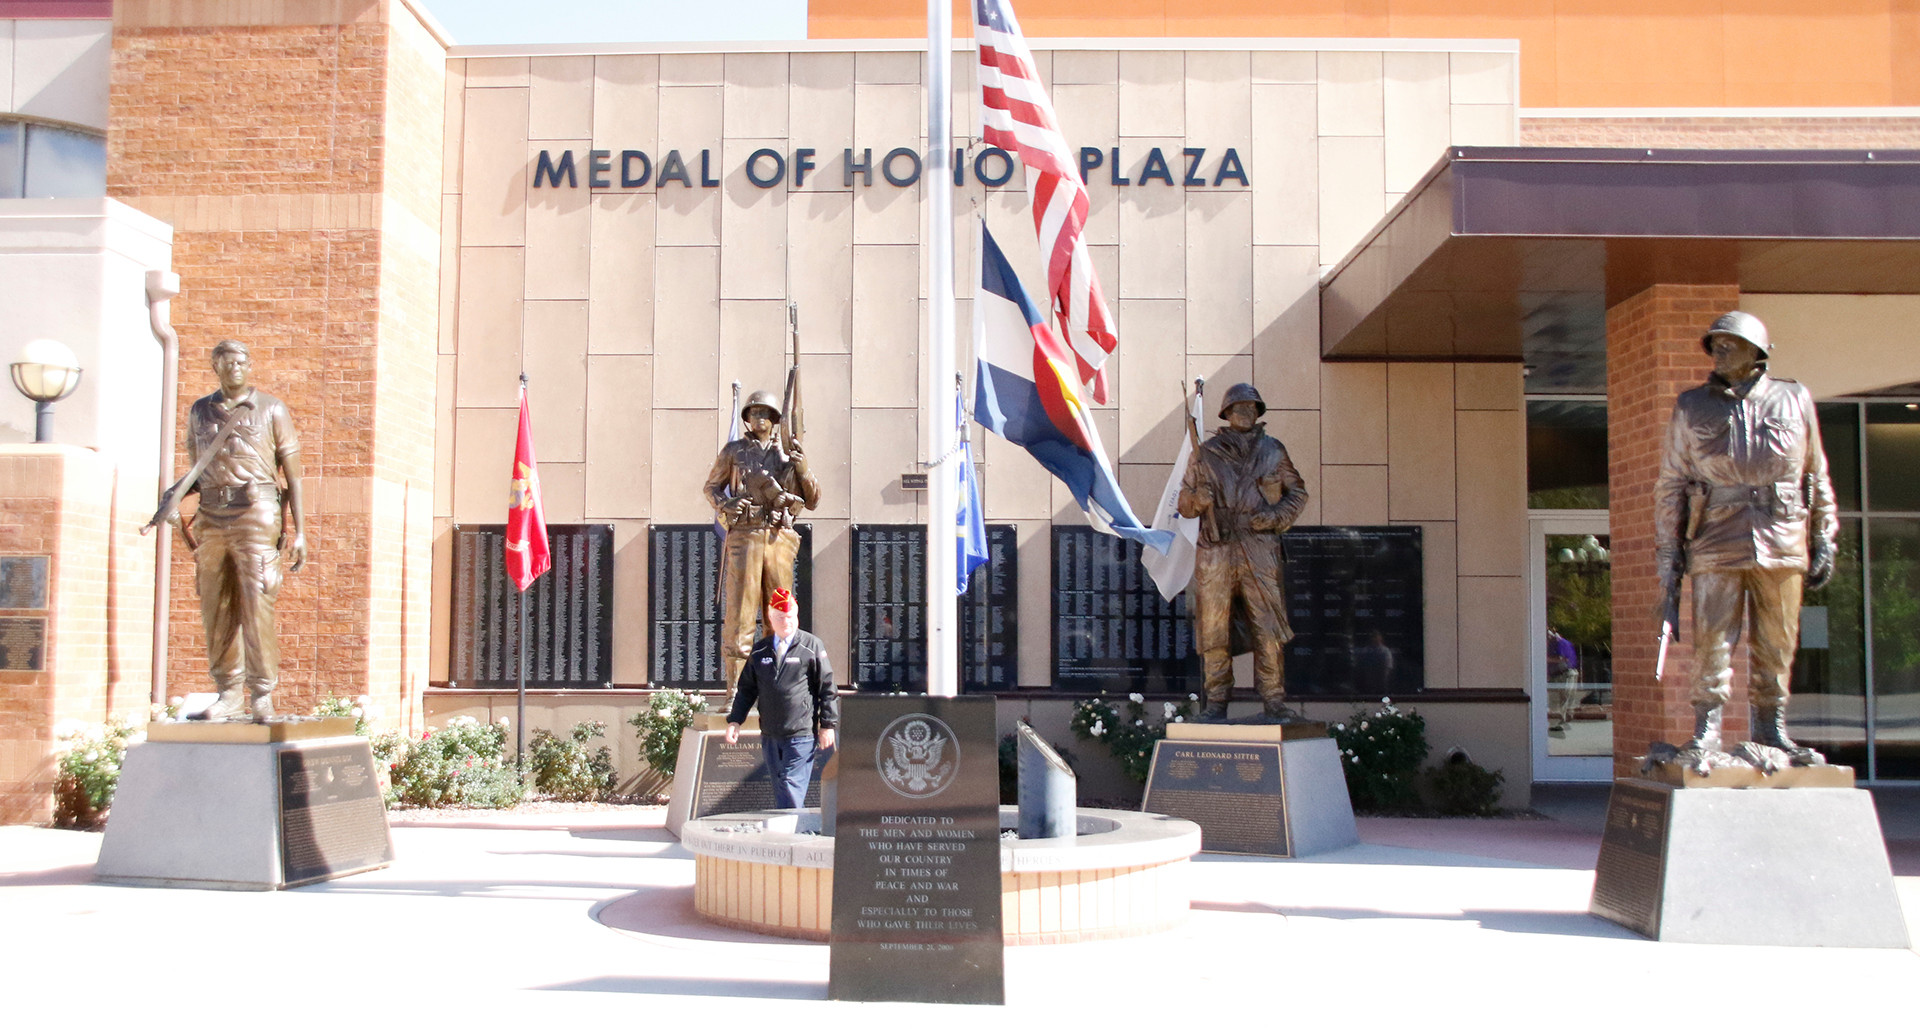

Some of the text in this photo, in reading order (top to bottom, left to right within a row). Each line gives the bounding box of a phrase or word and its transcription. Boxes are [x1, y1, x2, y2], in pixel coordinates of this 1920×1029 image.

[533, 146, 1250, 189] MEDAL OF HOO PLAZA
[719, 742, 754, 750] WILLIAM
[1175, 750, 1260, 761] CARL LEONARD SITTER
[881, 815, 954, 825] DEDICATED TO
[860, 828, 975, 838] THE MEN AND WOMEN
[713, 842, 735, 853] THERE
[869, 842, 966, 851] WHO HAVE SERVED
[880, 855, 953, 864] OUR COUNTRY
[885, 868, 948, 877] IN TIMES OF
[875, 881, 959, 891] PEACE AND WAR
[906, 895, 929, 903] AND
[861, 907, 973, 917] ESPECIALLY TO THOSE
[857, 920, 978, 930] WHO GAVE THEIR LIVES
[880, 943, 923, 951] SEPTEMBER
